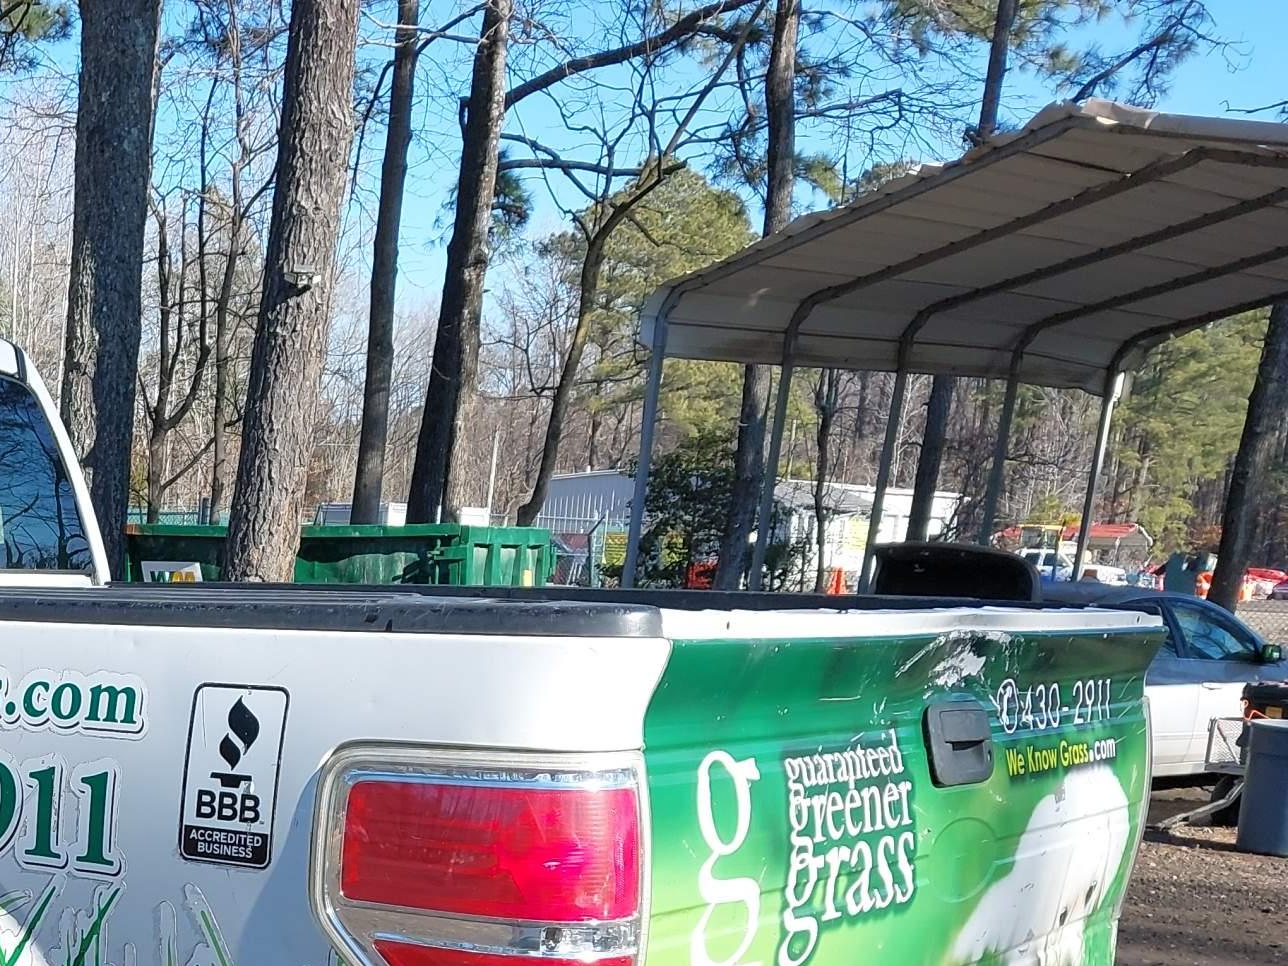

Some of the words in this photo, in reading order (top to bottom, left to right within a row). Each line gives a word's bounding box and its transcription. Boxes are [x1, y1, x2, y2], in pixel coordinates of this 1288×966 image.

[785, 728, 904, 798] guaranteed
[1006, 748, 1025, 776] We
[1027, 745, 1057, 773] Know
[1060, 738, 1116, 767] Grass.com
[195, 789, 260, 824] BBB
[789, 780, 912, 862] greener
[189, 828, 262, 847] ACCREDITED
[197, 841, 253, 859] BUSINESS
